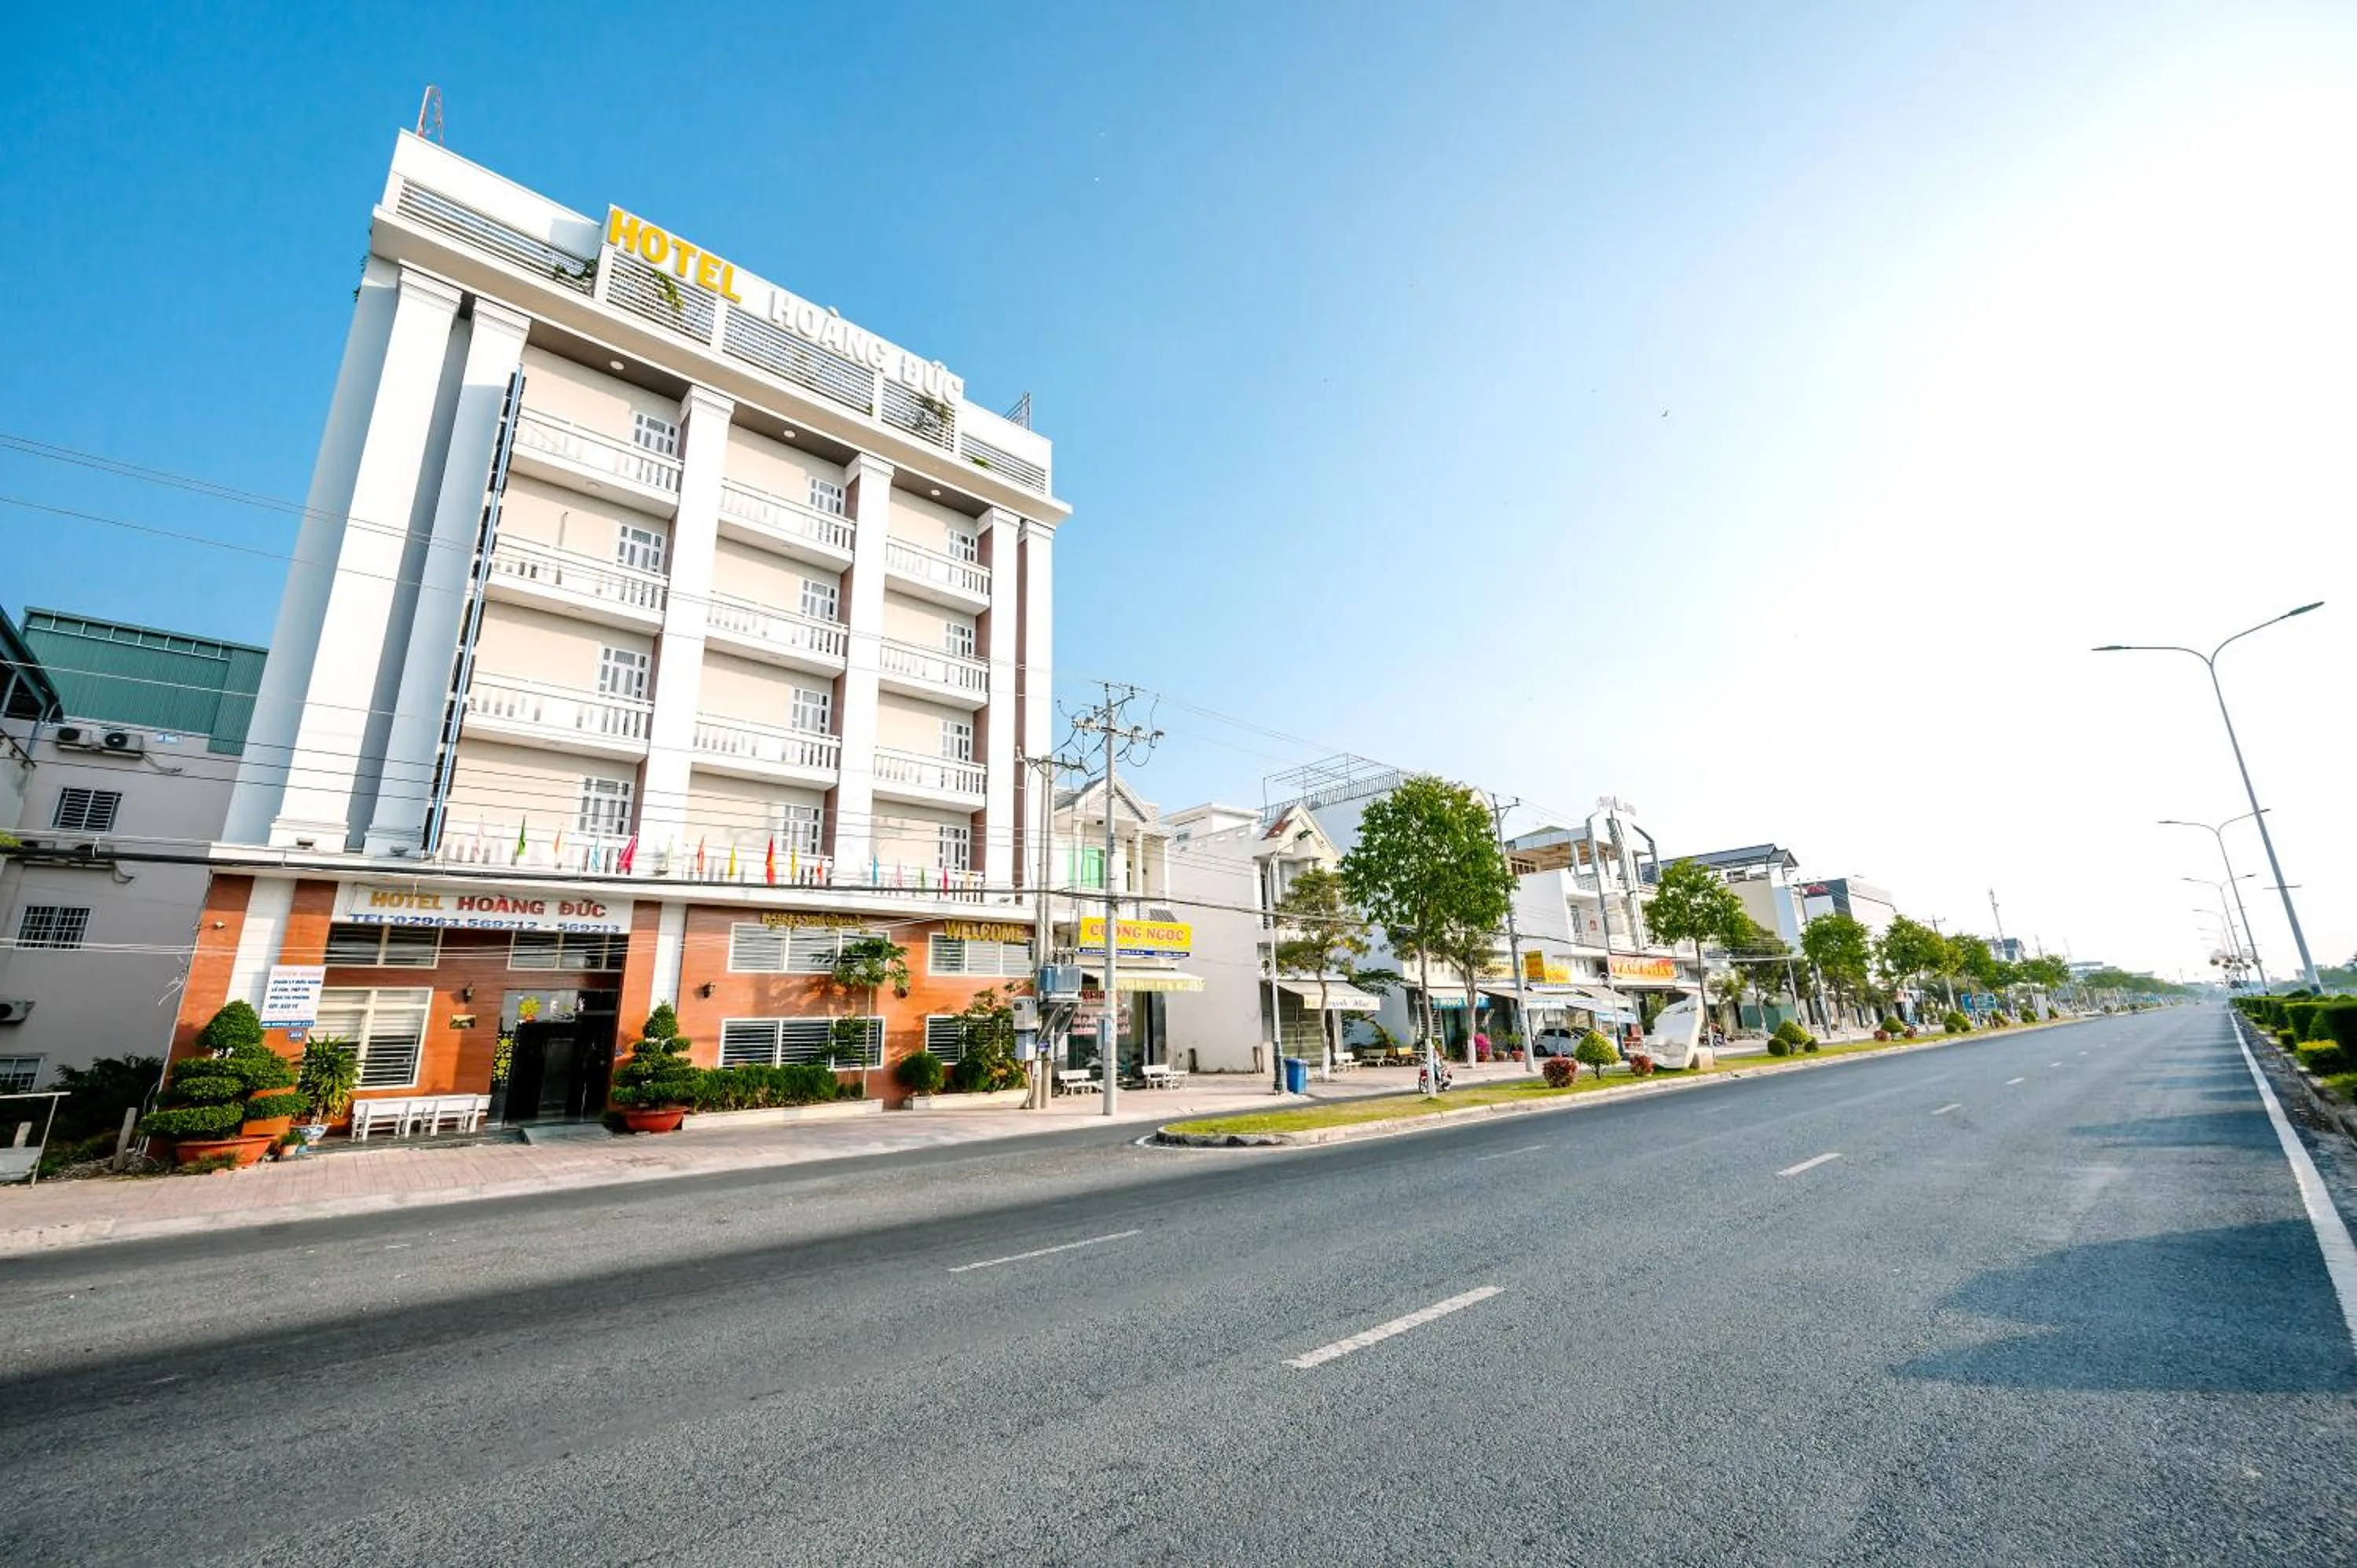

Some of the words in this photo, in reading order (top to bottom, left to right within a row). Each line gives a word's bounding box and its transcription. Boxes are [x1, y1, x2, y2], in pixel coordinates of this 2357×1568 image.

[608, 208, 742, 304] HOTEL
[768, 289, 886, 374] HOÀNG
[900, 355, 964, 406] ĐỨC
[369, 892, 443, 910] HOTEL
[456, 894, 546, 915] HOÀNG
[558, 897, 608, 918] ĐỨC
[944, 920, 1025, 942] WELCOME
[1146, 928, 1185, 943] NGỌC
